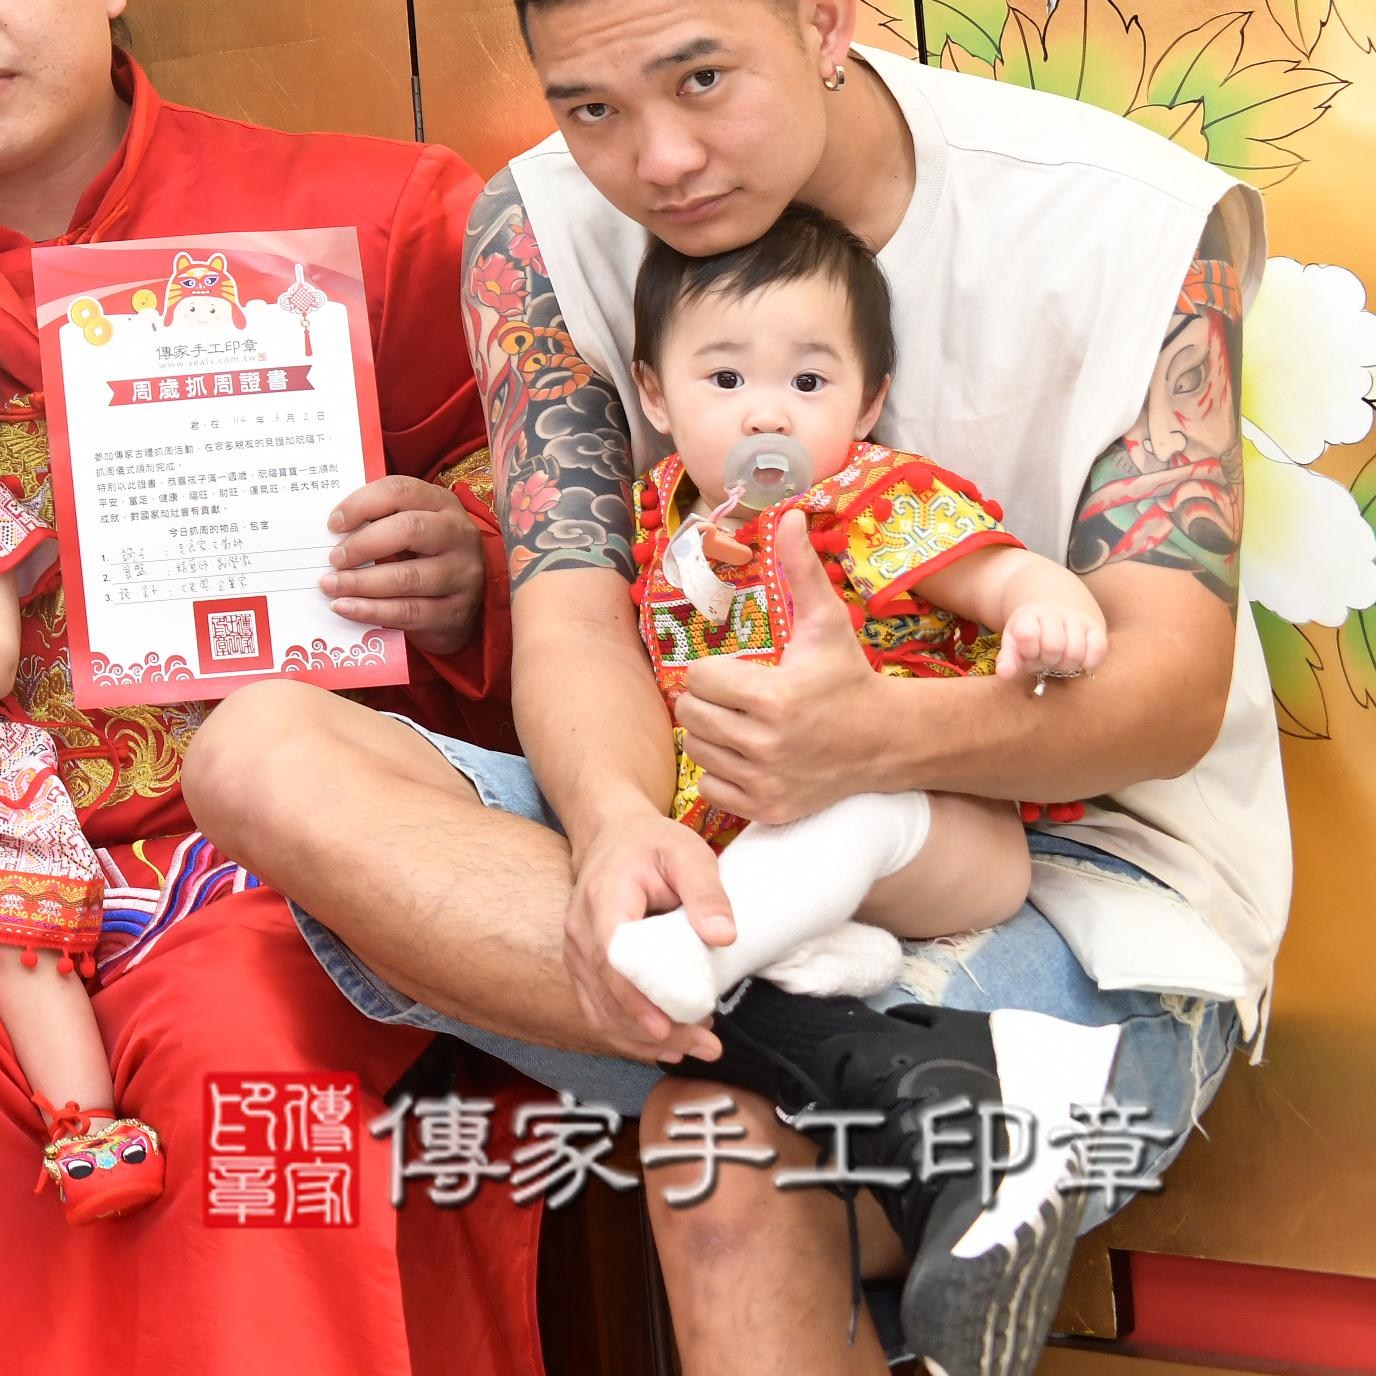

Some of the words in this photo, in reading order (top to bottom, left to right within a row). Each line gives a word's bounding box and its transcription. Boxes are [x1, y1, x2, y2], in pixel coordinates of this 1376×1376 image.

[156, 339, 258, 360] 傳家手工印章
[159, 355, 256, 369] www.seals.com.tw
[132, 369, 289, 402] 周歲抓周證書
